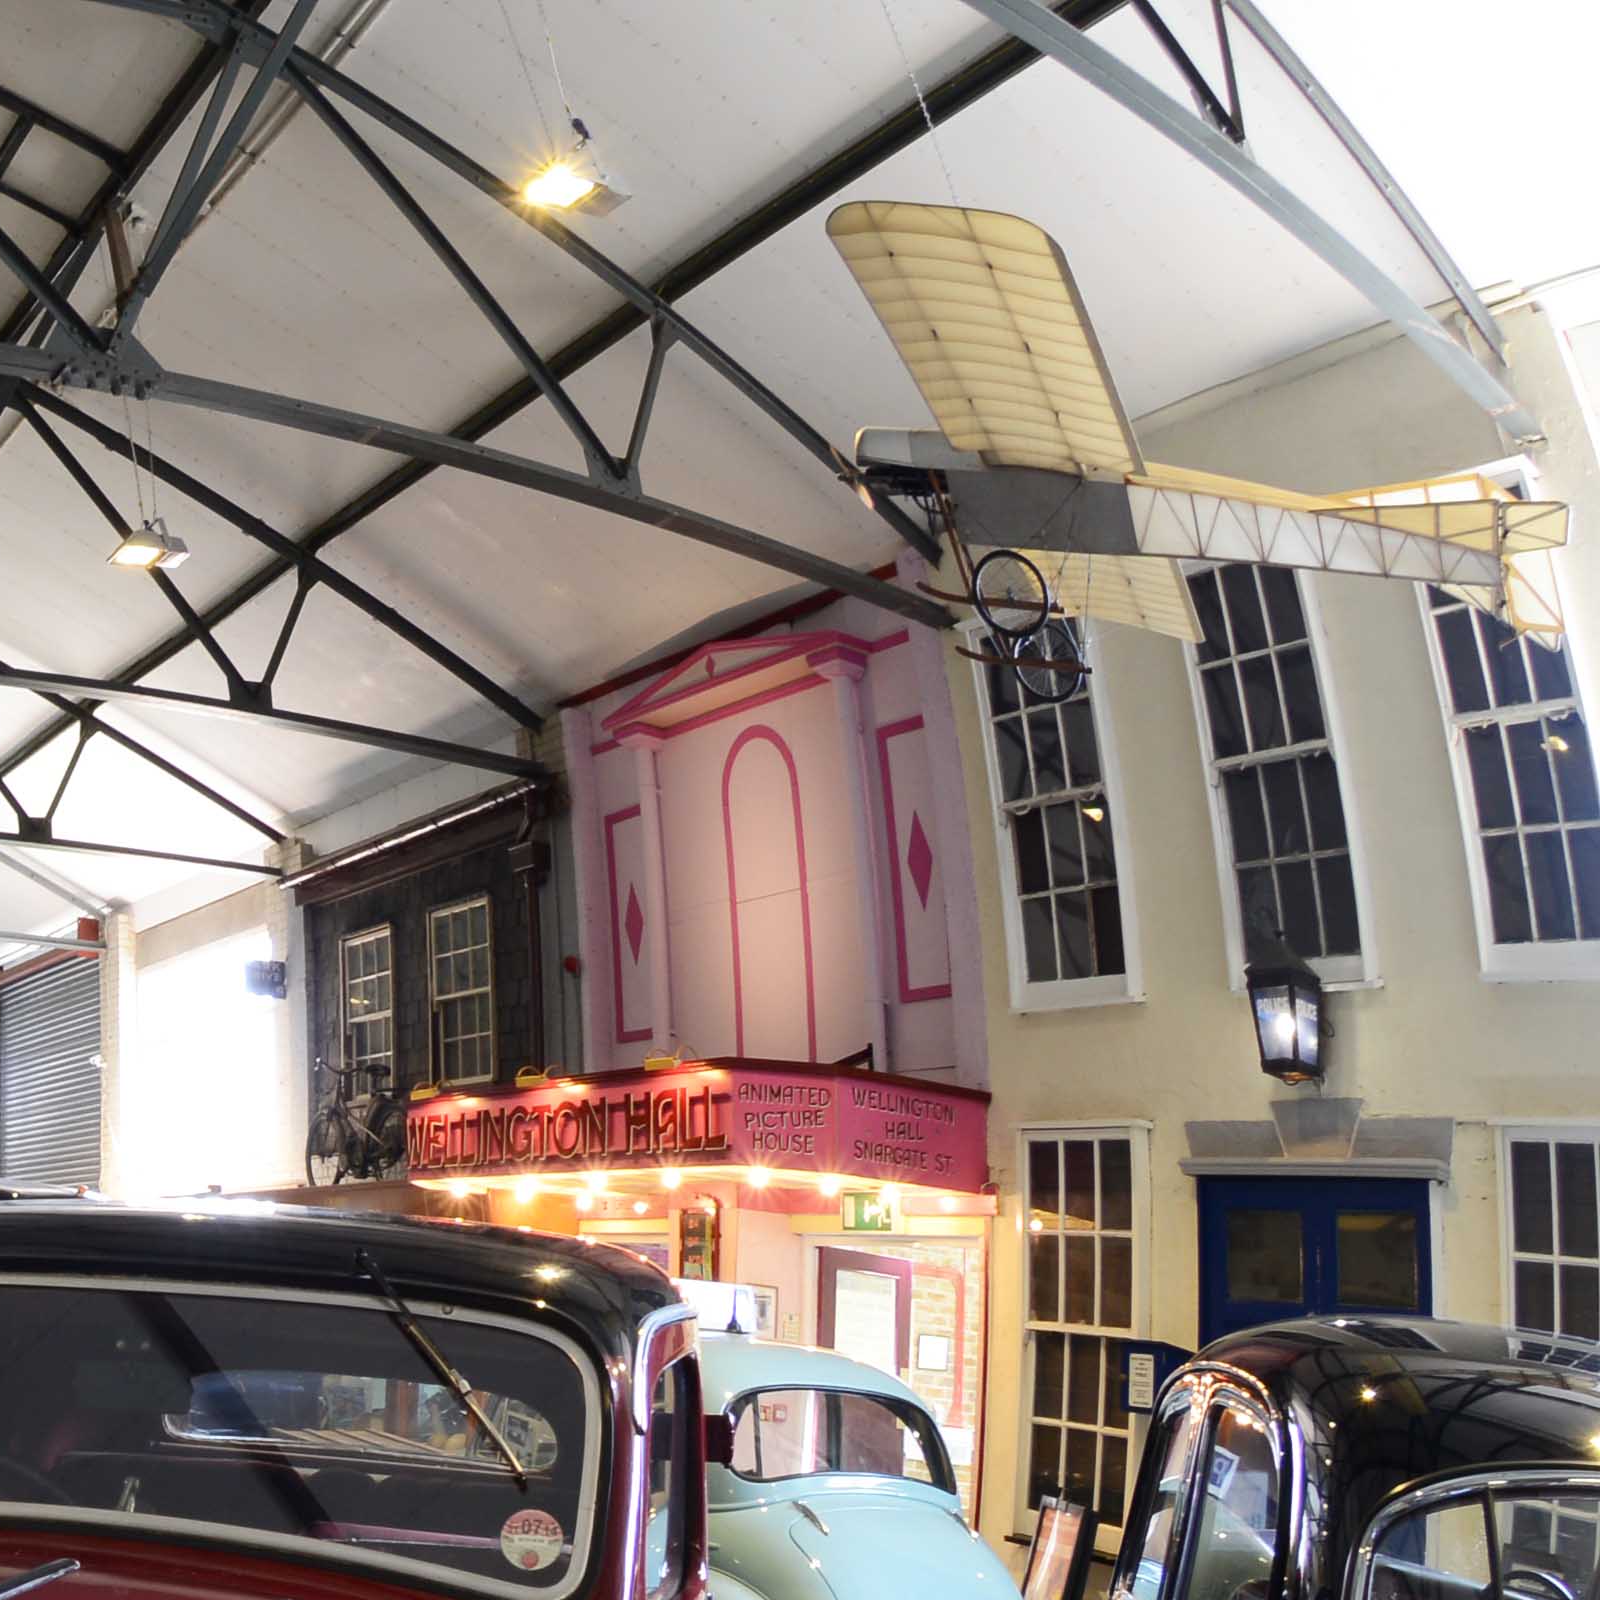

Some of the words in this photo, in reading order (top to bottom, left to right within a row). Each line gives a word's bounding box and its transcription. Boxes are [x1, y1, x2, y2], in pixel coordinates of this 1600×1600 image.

[738, 1082, 832, 1108] ANIMATED
[852, 1086, 957, 1127] WELLINGTON
[406, 1098, 609, 1169] WELLINGTON
[624, 1086, 730, 1155] HALL
[744, 1109, 826, 1131] PICTURE
[884, 1121, 925, 1143] HALL
[752, 1131, 816, 1156] HOUSE
[853, 1139, 929, 1171] SNARGATE
